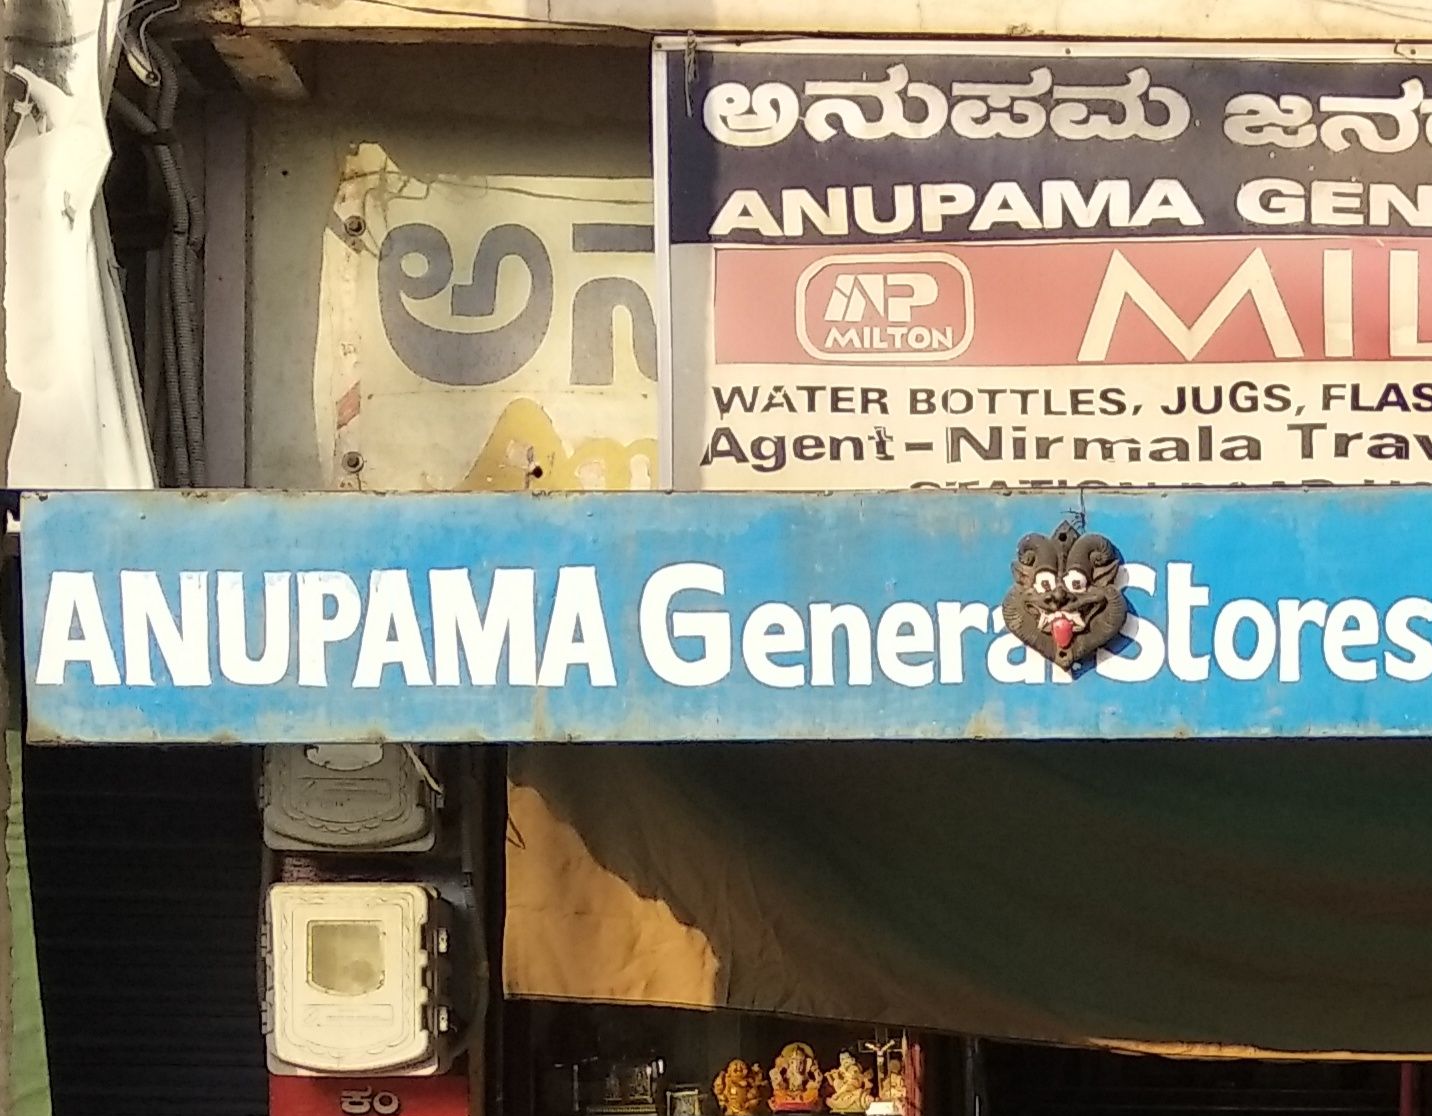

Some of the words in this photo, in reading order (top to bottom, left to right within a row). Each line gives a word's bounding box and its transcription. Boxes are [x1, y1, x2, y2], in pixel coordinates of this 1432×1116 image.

[702, 64, 1191, 147] ಅನುಪಮ
[710, 178, 1204, 237] ANUPAMA
[824, 325, 953, 349] MILTON
[712, 384, 890, 416] WATER
[909, 385, 1142, 420] BOTTLES,
[1160, 382, 1306, 420] JUGS,
[35, 565, 617, 688] ANUPAMA
[638, 561, 1073, 688] Genera
